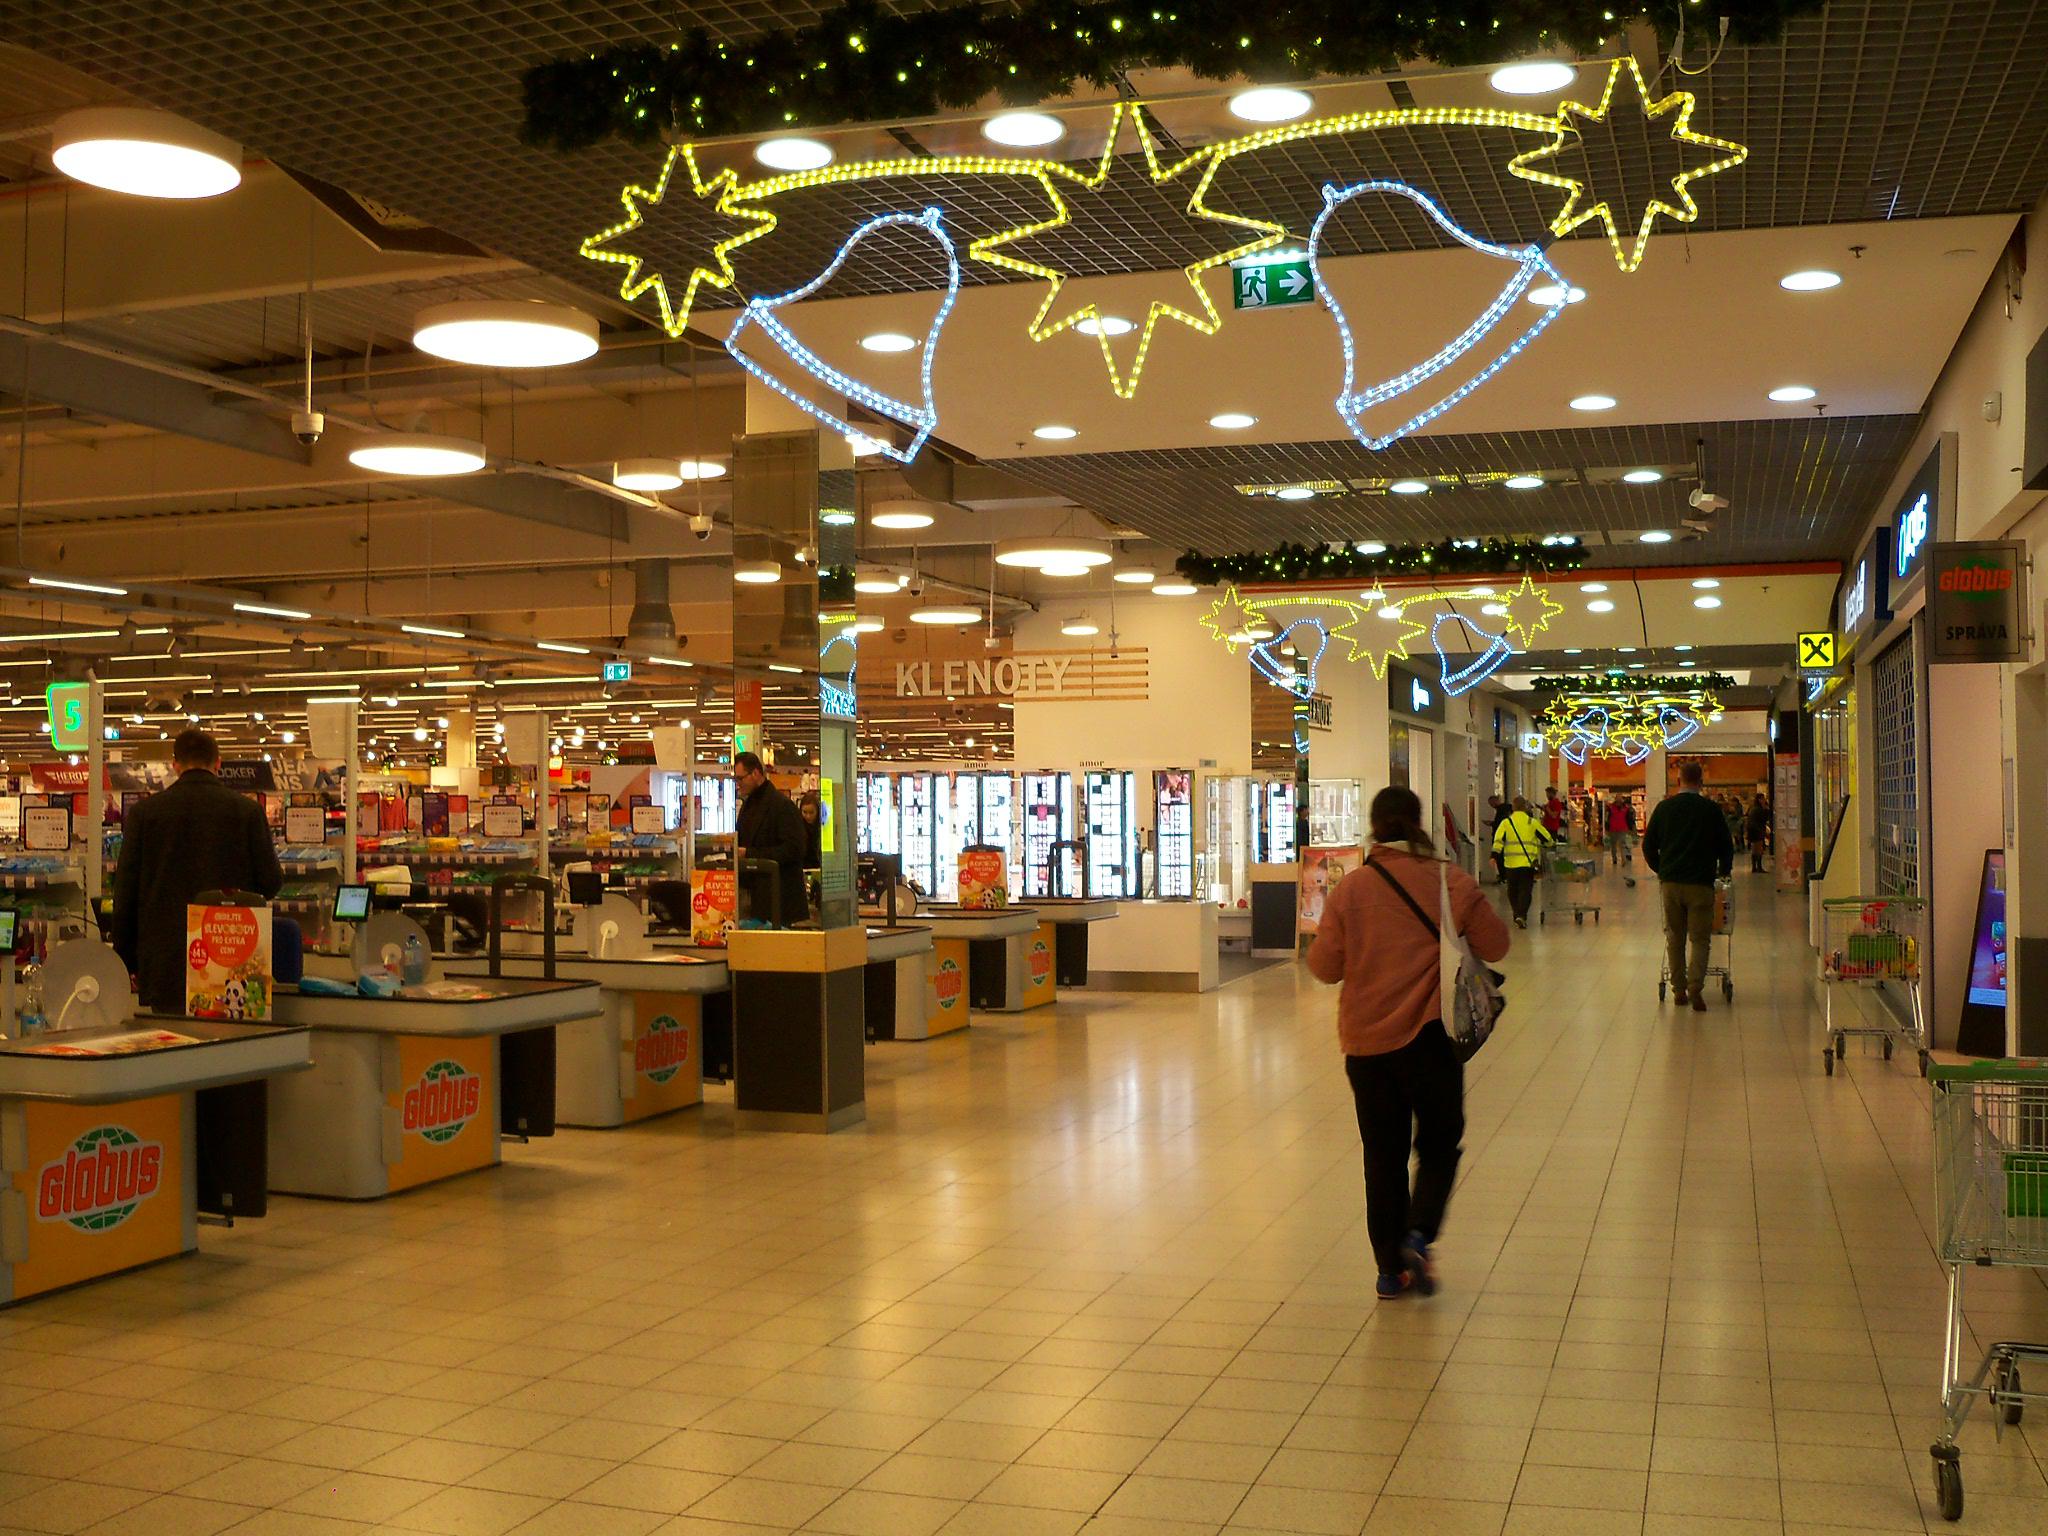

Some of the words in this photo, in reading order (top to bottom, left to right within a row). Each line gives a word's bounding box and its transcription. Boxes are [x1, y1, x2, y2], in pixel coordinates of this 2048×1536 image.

[1939, 566, 2014, 592] Globus
[896, 658, 1072, 697] KLENOTY
[65, 700, 81, 731] 5
[214, 767, 256, 778] OOKER
[964, 760, 989, 769] amor
[1079, 759, 1105, 768] amor
[403, 1070, 480, 1130] Globus
[39, 1142, 161, 1217] Globus
